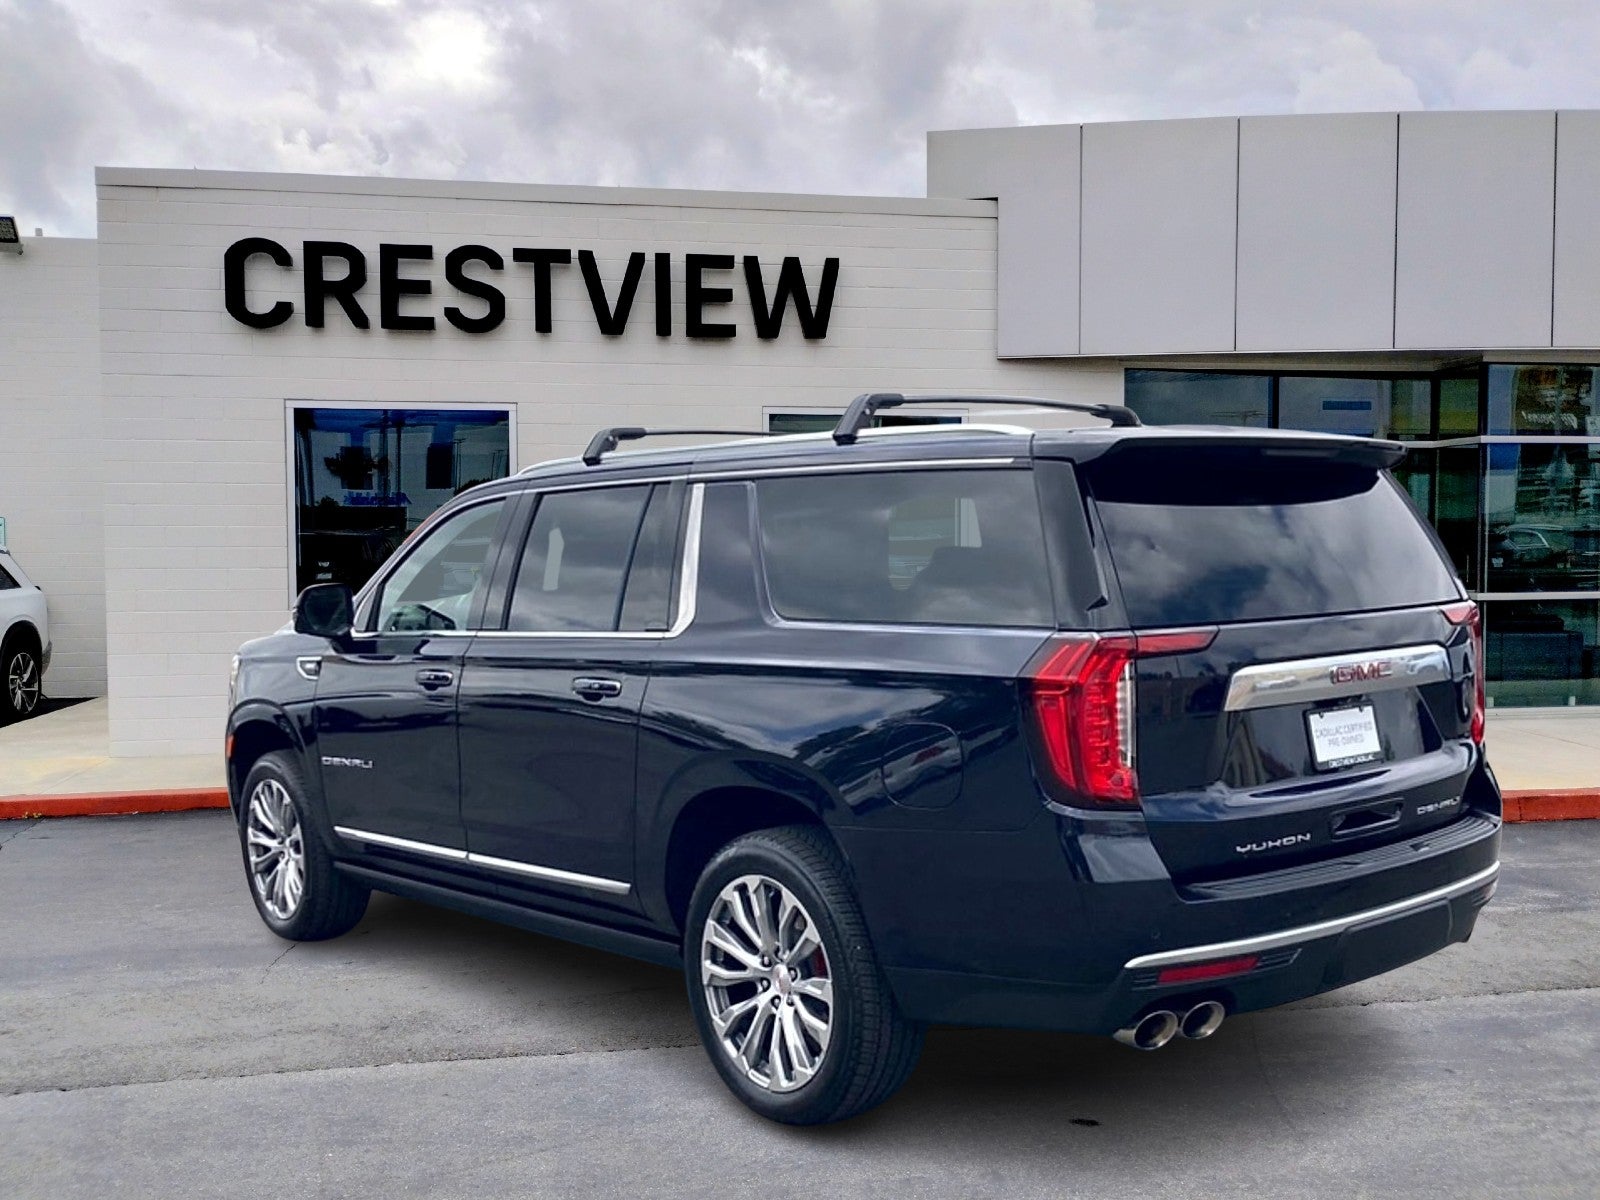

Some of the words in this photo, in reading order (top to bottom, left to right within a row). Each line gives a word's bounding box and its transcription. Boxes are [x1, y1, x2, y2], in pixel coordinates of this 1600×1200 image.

[224, 237, 839, 339] CRESTVIEW
[1331, 661, 1392, 684] GMC
[321, 756, 373, 769] DENALI
[1417, 796, 1460, 815] DENALI
[1236, 833, 1311, 853] YUKON
